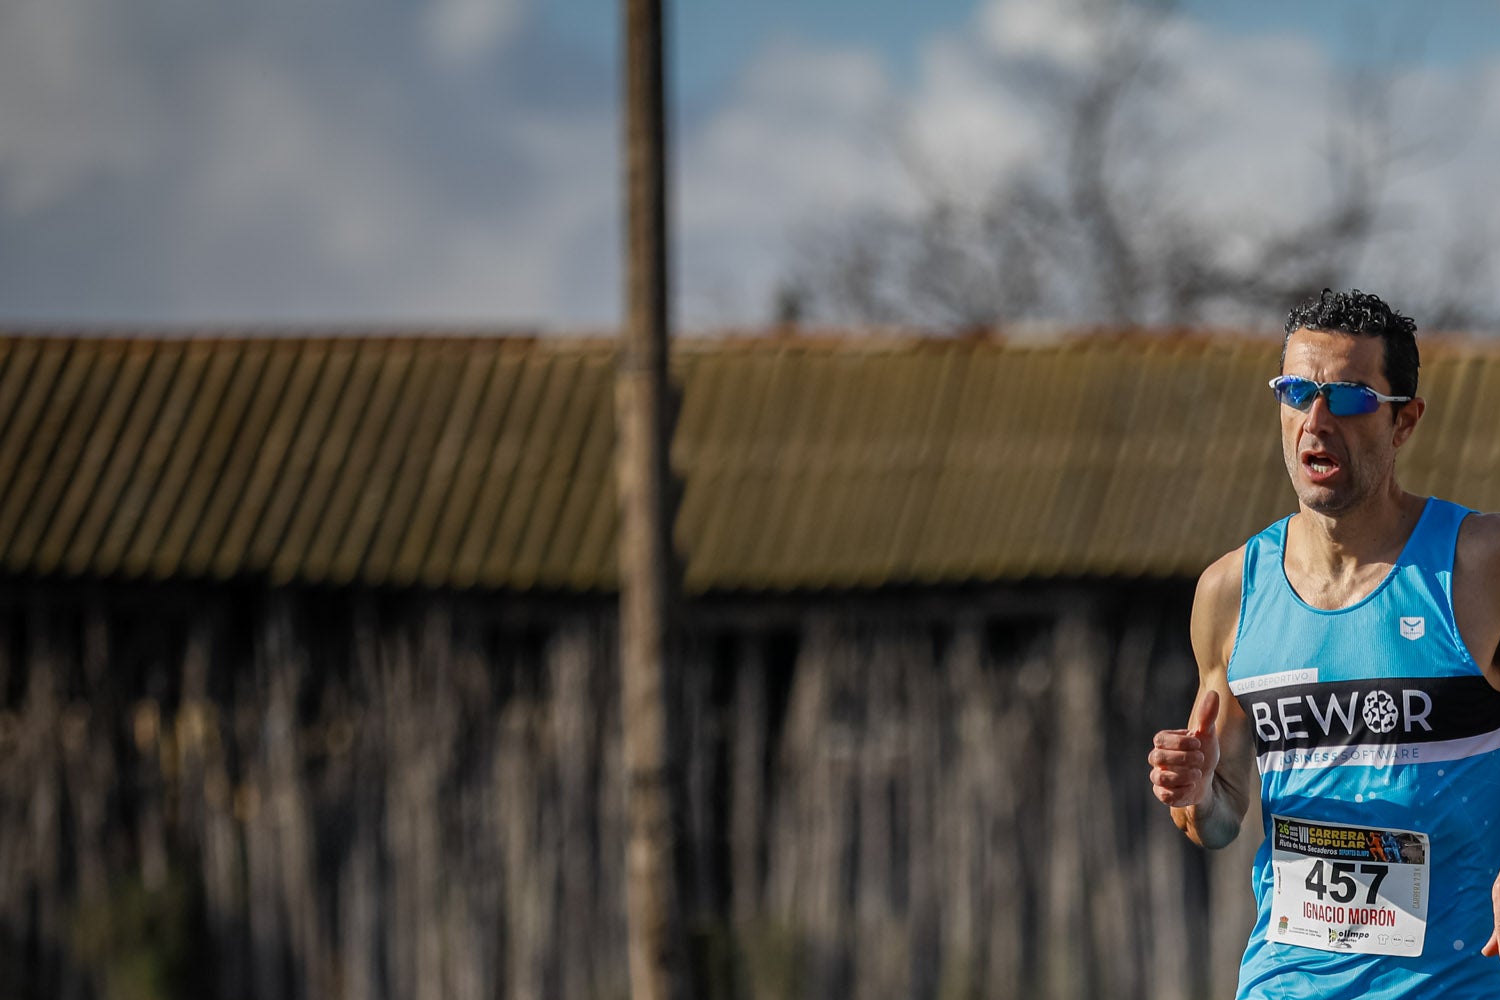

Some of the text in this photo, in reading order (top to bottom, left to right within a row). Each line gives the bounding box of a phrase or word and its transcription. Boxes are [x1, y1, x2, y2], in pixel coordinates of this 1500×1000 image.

[1237, 672, 1309, 692] CLUB DEPORTIVO
[1279, 823, 1290, 835] 26
[1299, 826, 1309, 843] VII
[1309, 828, 1365, 841] CARRERA
[1279, 839, 1292, 848] Ruta
[1307, 844, 1338, 855] Secaderos
[1309, 837, 1366, 849] POPULAR
[1305, 859, 1389, 905] 457
[1303, 901, 1396, 927] IGNACIO MORÓN
